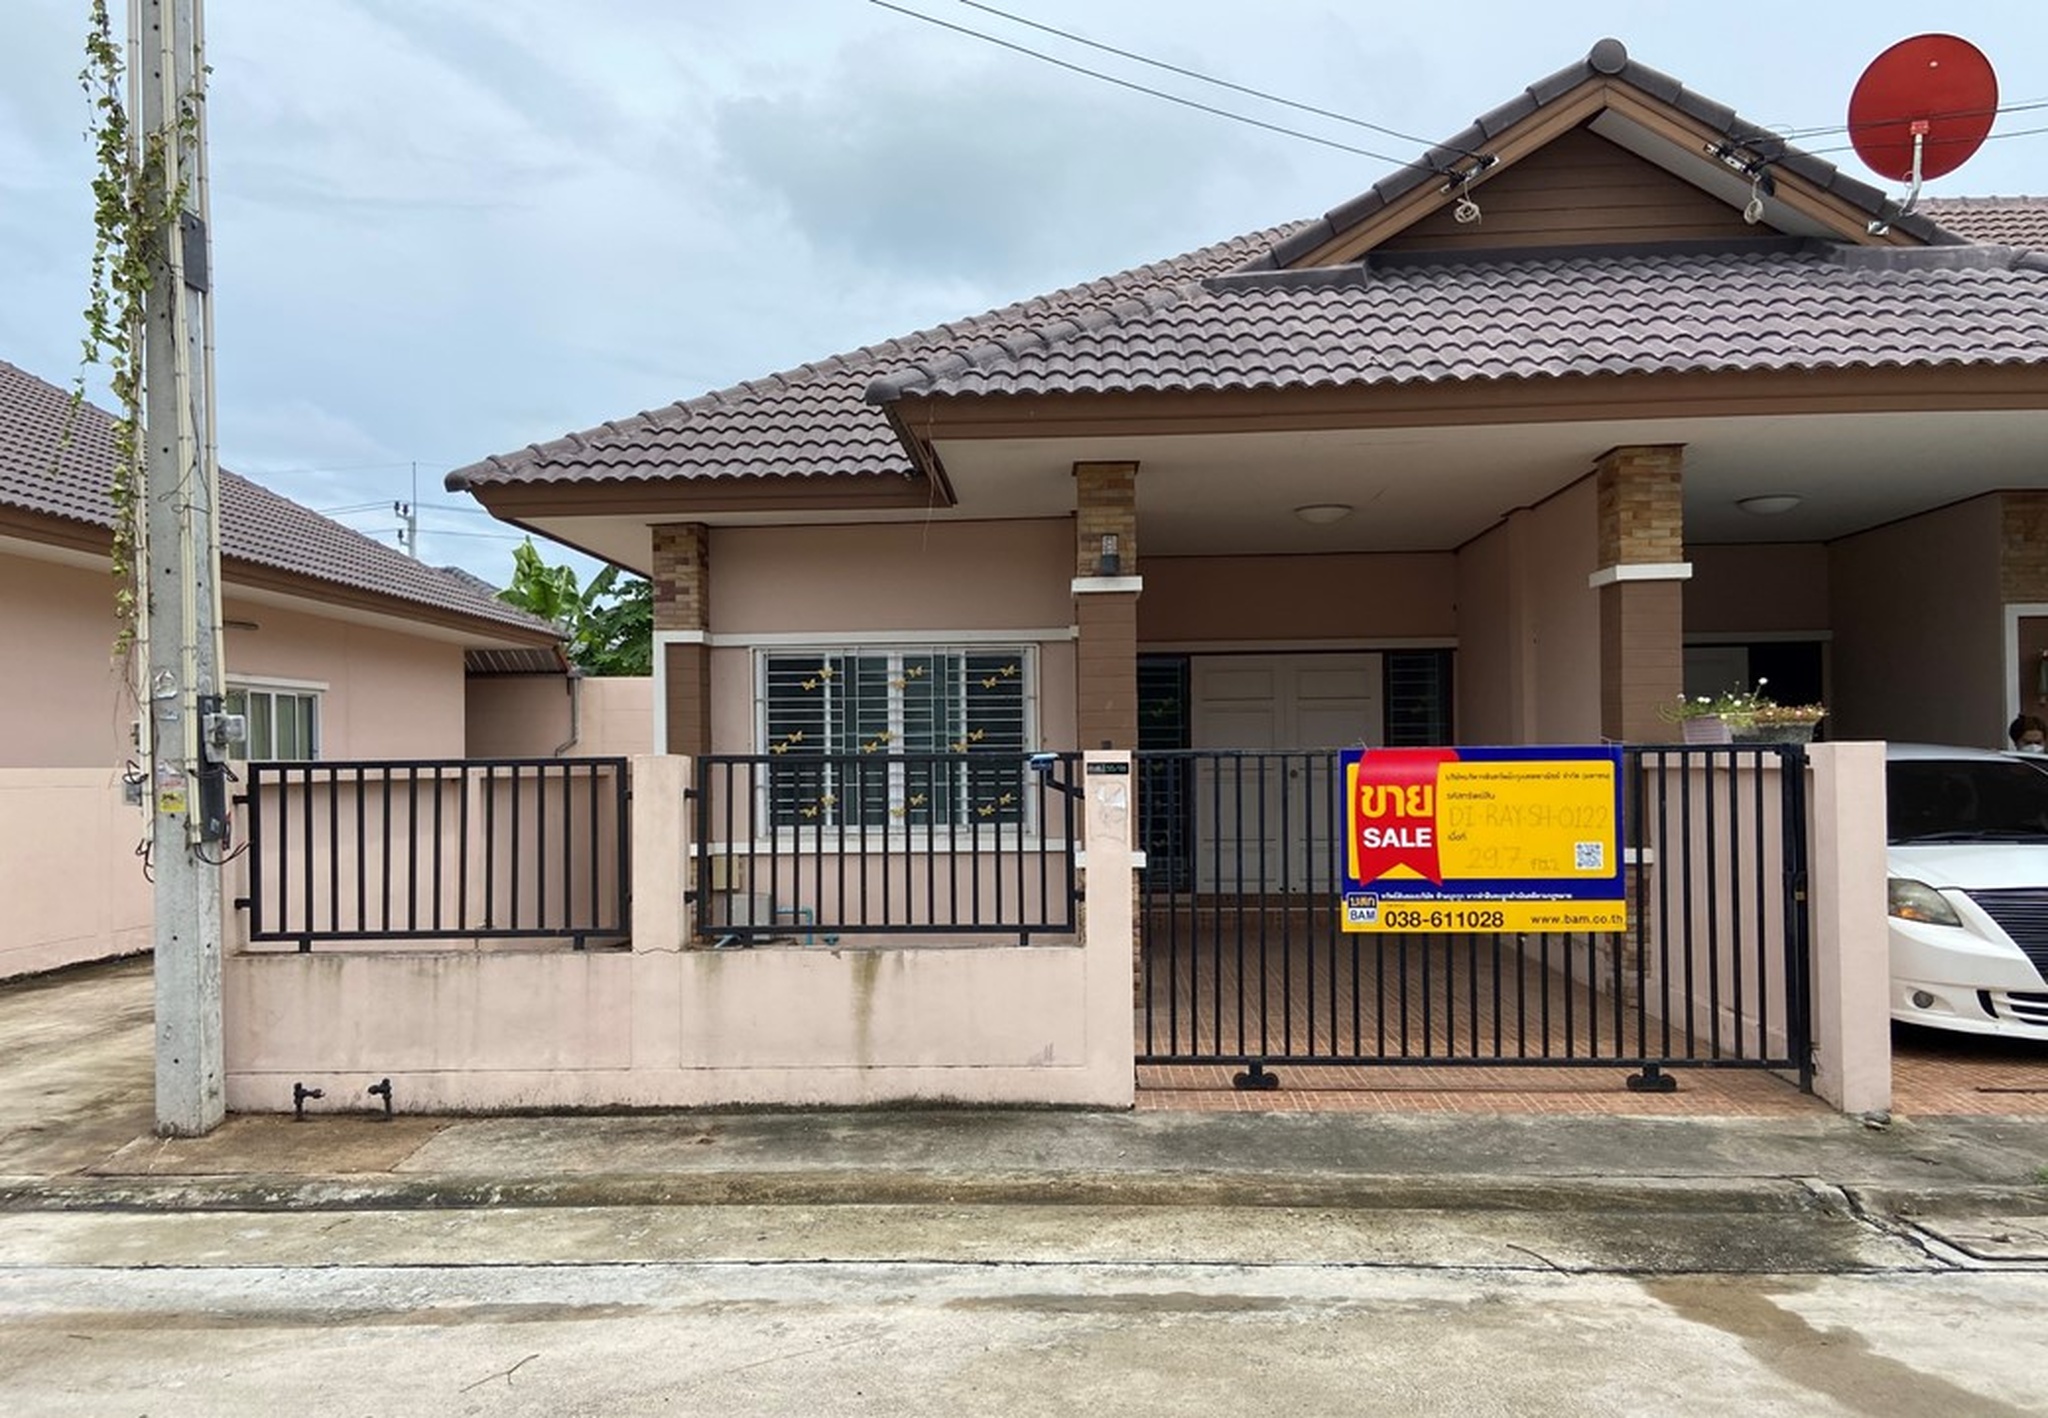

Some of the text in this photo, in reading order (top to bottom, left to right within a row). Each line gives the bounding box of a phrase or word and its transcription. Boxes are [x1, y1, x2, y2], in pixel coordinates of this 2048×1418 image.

[1361, 785, 1433, 818] ขาย
[1363, 827, 1432, 848] SALE
[1350, 910, 1375, 921] BAM
[1385, 911, 1504, 928] 038-611028
[1531, 914, 1624, 925] www.bam.co.th
